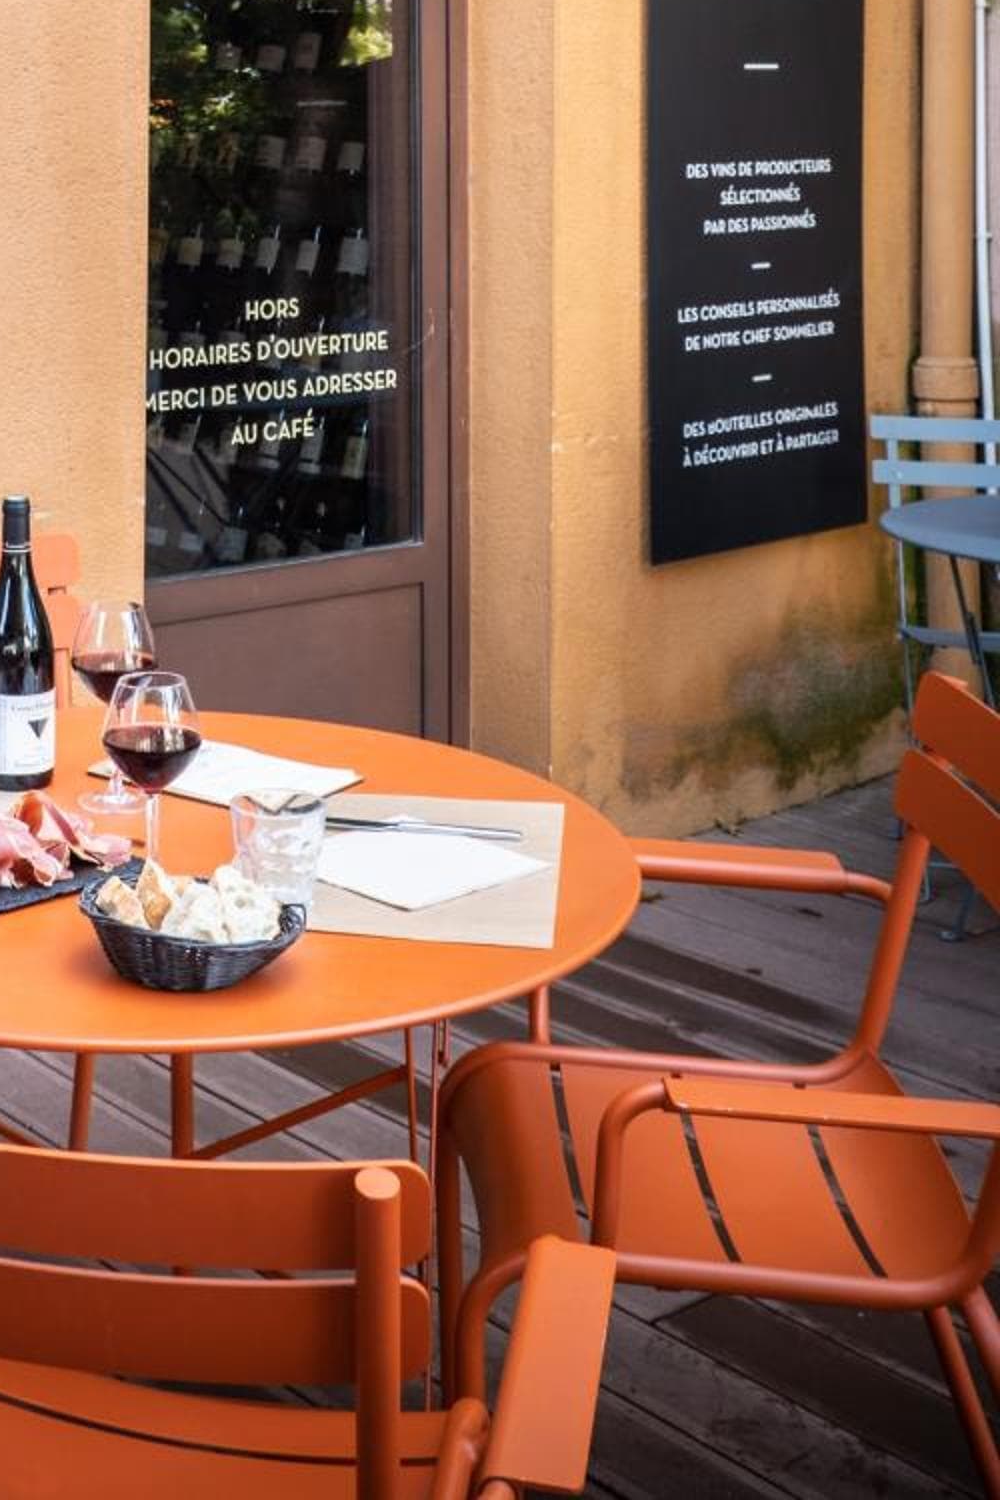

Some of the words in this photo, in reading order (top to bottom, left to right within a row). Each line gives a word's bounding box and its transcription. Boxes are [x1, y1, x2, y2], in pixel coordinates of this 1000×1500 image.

[686, 163, 708, 179] DES
[710, 161, 736, 177] VINS
[738, 161, 752, 177] DE
[755, 158, 832, 175] PRODUCTEURS
[720, 181, 801, 205] SÉLECTIONNÉS
[703, 218, 726, 235] PAR
[728, 217, 748, 233] DES
[751, 207, 816, 231] PASSIONNÉS
[245, 298, 300, 321] HORS
[677, 306, 699, 323] LES
[700, 301, 754, 321] CONSEILS
[756, 286, 840, 315] PERSONNALISÉS
[149, 342, 251, 370] HORAIRES
[257, 330, 389, 361] D'OUVERTURE
[685, 335, 700, 351] DE
[702, 331, 740, 349] NOTRE
[742, 327, 772, 345] CHEF
[774, 320, 835, 341] SOMMELIER
[211, 384, 238, 407] DE
[243, 377, 297, 402] VOUS
[303, 369, 398, 397] ADRESSER
[231, 423, 257, 445] AU
[263, 407, 315, 442] CAFÉ
[683, 421, 705, 438] DES
[707, 411, 773, 435] BOUTEILLES
[775, 401, 838, 424] ORIGINALES
[682, 445, 692, 467] À
[693, 441, 759, 466] DÉCOUVRIR
[760, 438, 774, 455] ET
[775, 430, 785, 452] À
[786, 429, 839, 450] PARTAGER
